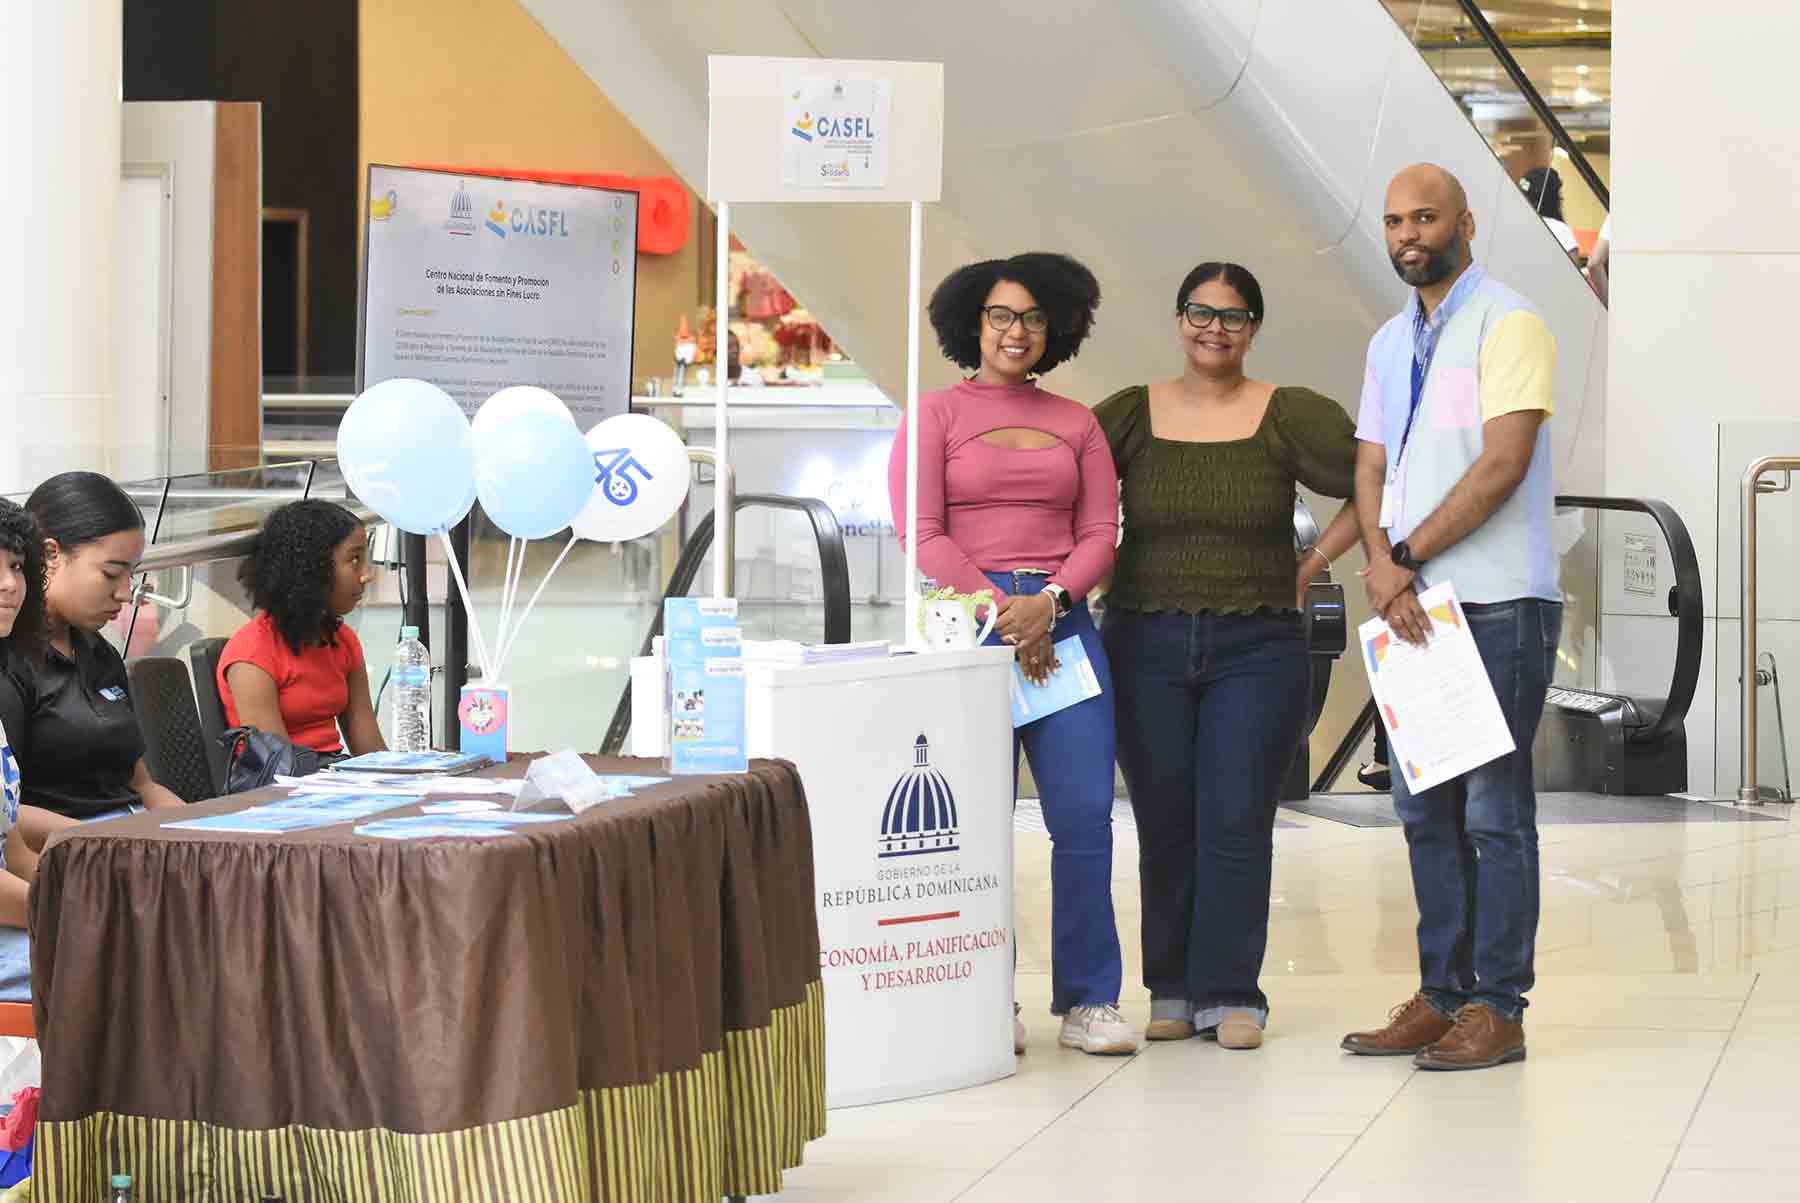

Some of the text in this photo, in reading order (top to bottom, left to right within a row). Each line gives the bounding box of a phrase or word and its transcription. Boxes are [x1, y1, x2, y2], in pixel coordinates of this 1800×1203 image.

[817, 116, 873, 138] CASFL
[512, 207, 568, 237] CASFL
[426, 269, 447, 280] Centro
[448, 271, 475, 283] Nacional
[476, 272, 484, 282] de
[485, 273, 511, 284] Fomento
[437, 284, 445, 294] de
[446, 284, 455, 294] las
[456, 285, 495, 297] Asociaciones
[496, 288, 506, 297] sin
[507, 288, 522, 299] Fines
[593, 449, 653, 506] 45
[877, 862, 961, 881] GOBIERNO DE LA
[823, 873, 999, 908] REPÚBLICA DOMINICANA
[818, 926, 1008, 969] CONOMÍA, PLANIFICACIÓN
[861, 959, 972, 991] Y DESARROLLO
